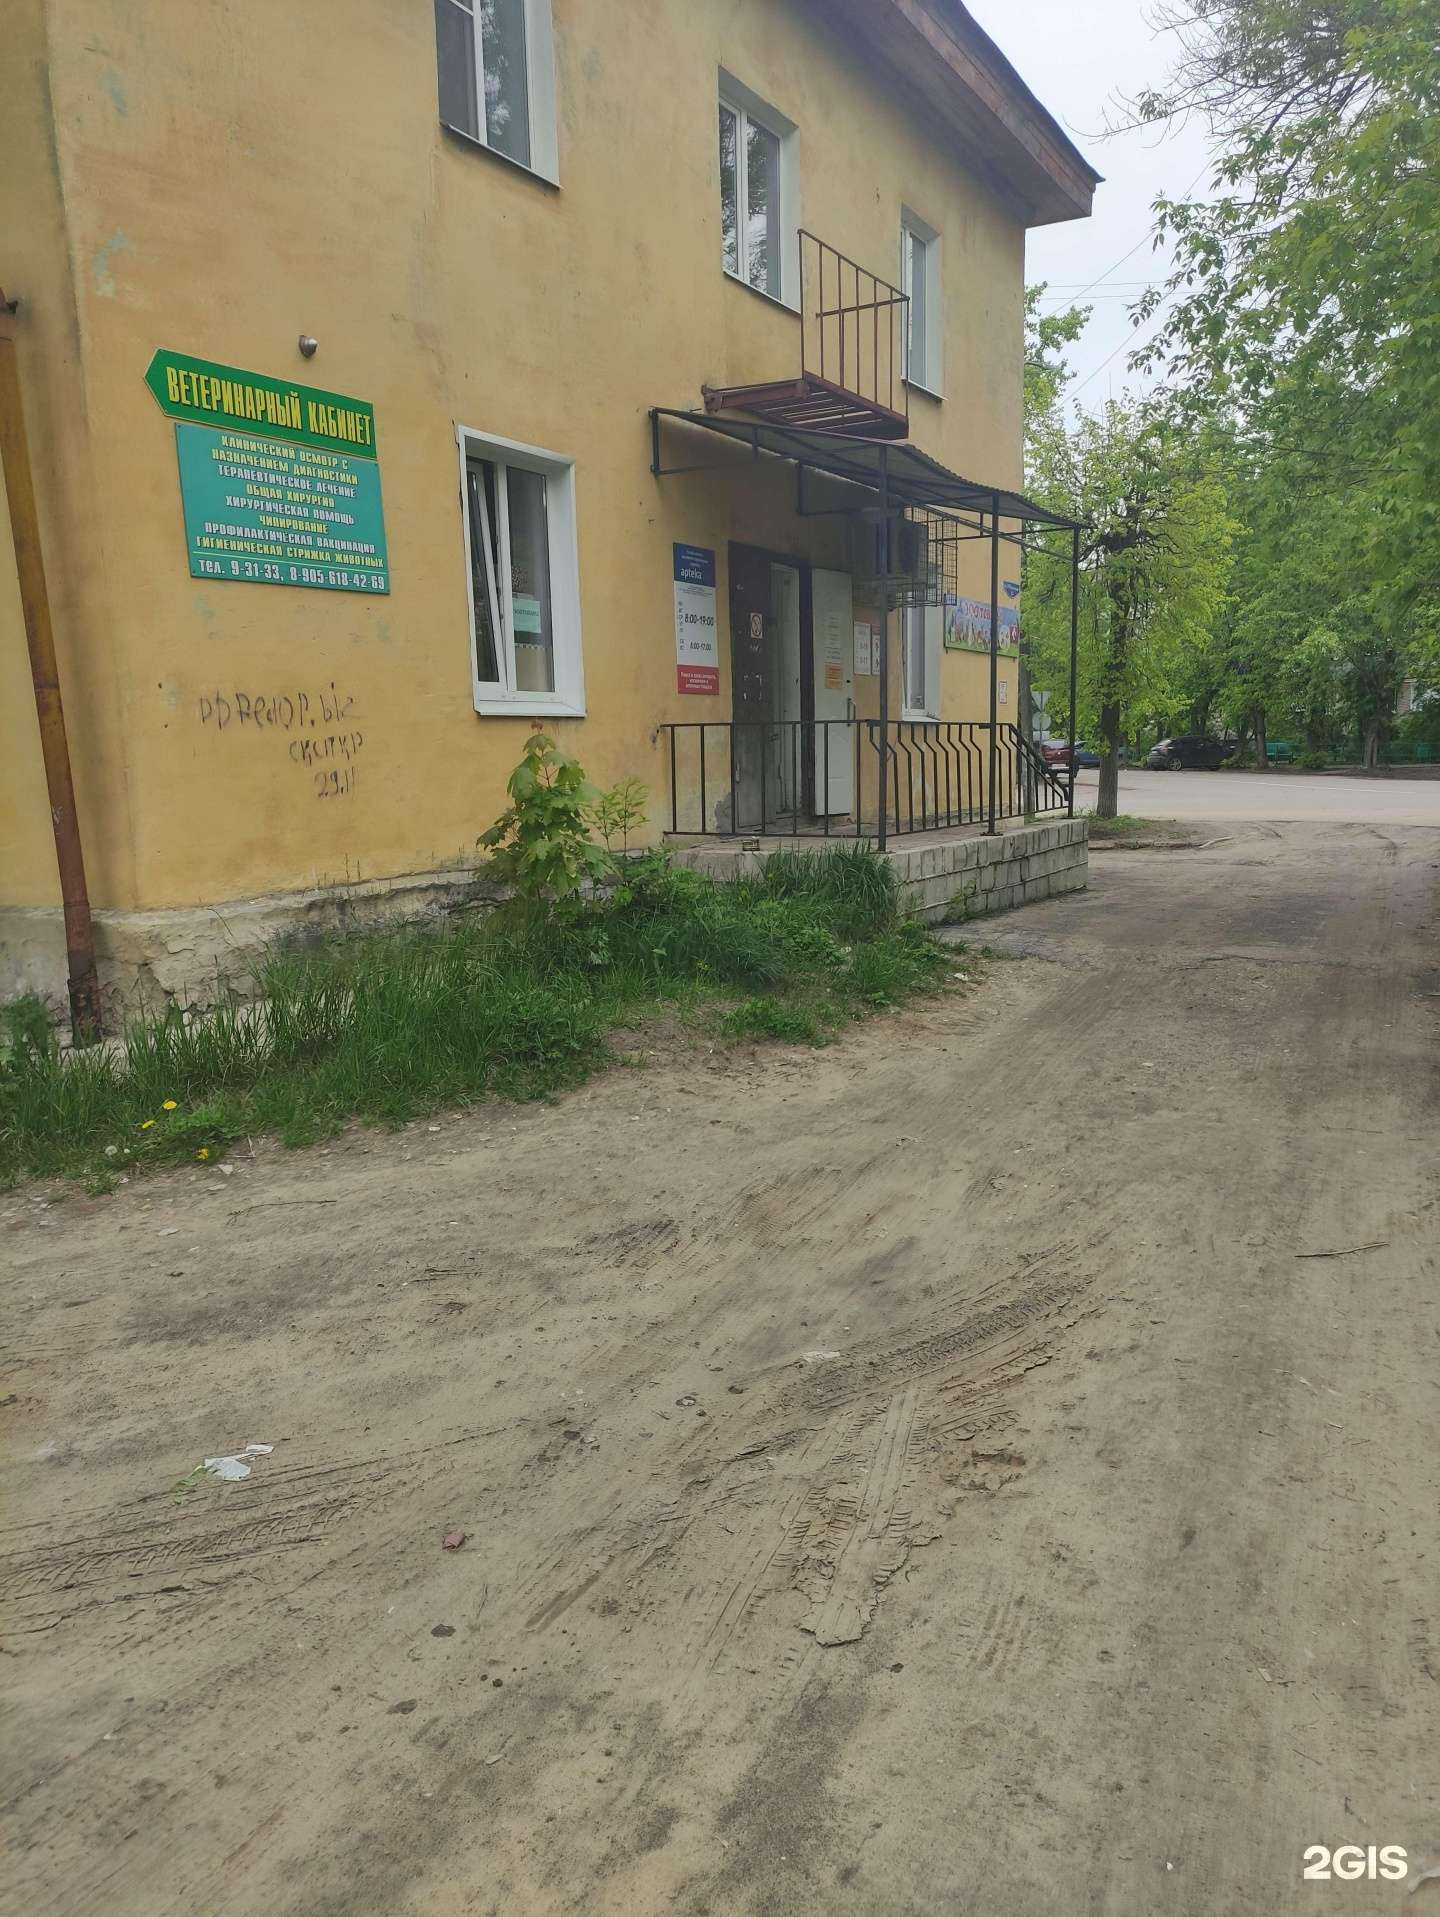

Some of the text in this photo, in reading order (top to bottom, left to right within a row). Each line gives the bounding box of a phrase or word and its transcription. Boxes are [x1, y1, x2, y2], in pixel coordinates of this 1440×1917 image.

[166, 367, 371, 445] ВЕТЕРИНАРНЫЙ КАБИНЕТ
[212, 449, 358, 484] НАЗНАЧЕНИЕМ ДИАГНОСТИКИ
[221, 435, 348, 470] КЛИНИЧЕСКИЙ ОСМОТР С
[218, 464, 356, 498] ТЕРАПЕВТИЧЕСКОЕ ЛЕЧЕНИЕ
[246, 483, 335, 508] ОБЩАЯ ХИРУРГИЯ
[225, 495, 354, 525] ХИРУРГИЧЕСКАЯ ПОМОЩЬ
[260, 515, 329, 534] ЧИПИРОВАНИЕ
[197, 536, 384, 568] ГИГИЕНИЧЕСКАЯ СТРИЖКА ЖИВОТНЫХ
[204, 522, 375, 554] ПРОФИЛАКТИЧЕСКАЯ ВАКЦИНАЦИЯ
[231, 561, 284, 581] 9-31-33,
[290, 567, 385, 590] 8-905-618-42-69
[680, 567, 703, 580] apteka
